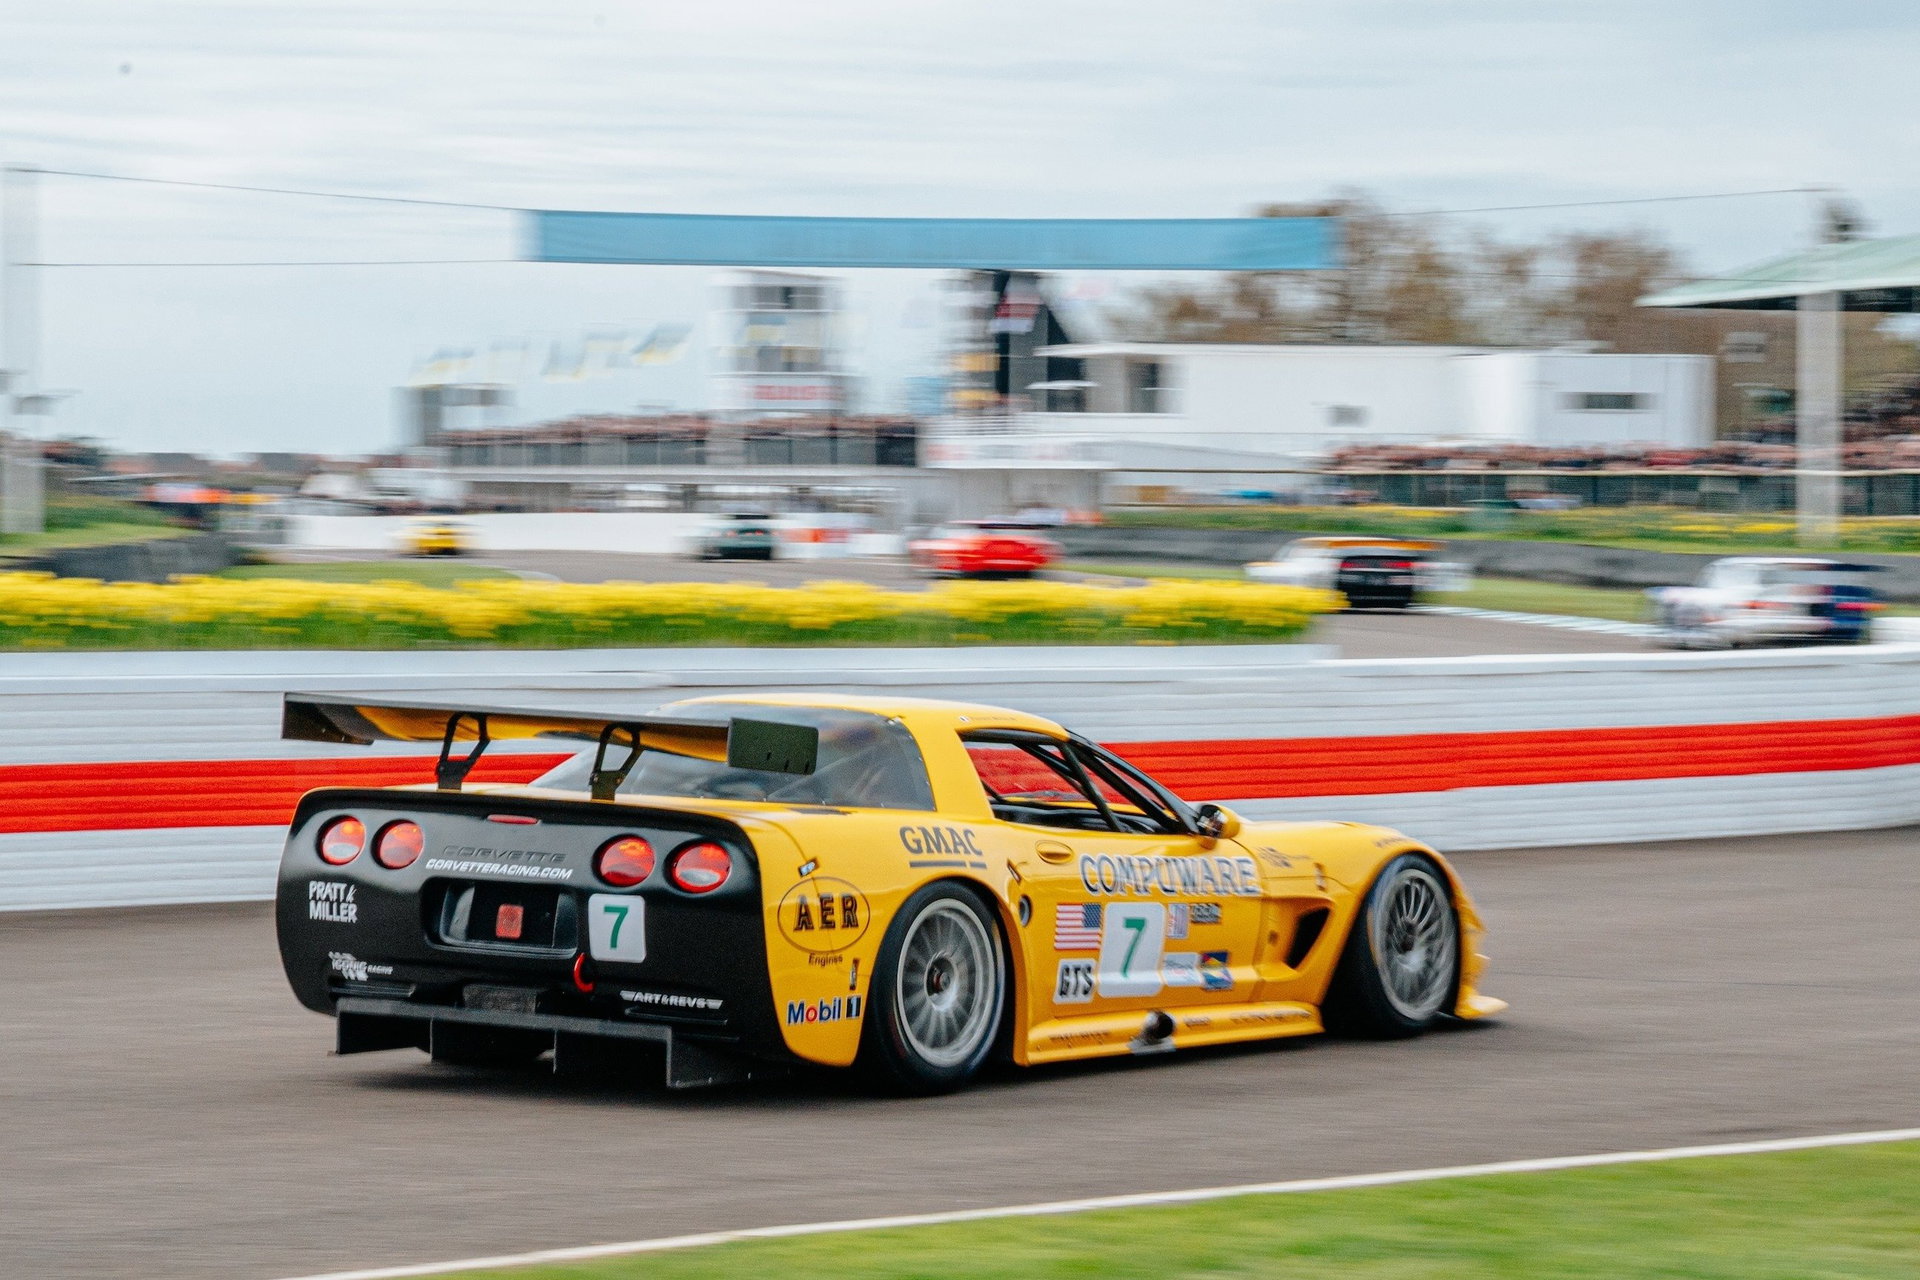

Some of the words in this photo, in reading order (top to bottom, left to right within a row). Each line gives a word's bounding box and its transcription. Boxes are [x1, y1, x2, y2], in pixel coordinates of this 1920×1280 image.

[443, 846, 567, 863] CORVETTE
[900, 826, 983, 856] GMAC
[425, 858, 574, 880] CORVETTERACING.COM
[1081, 855, 1261, 896] COMPUWARE
[309, 881, 347, 902] PRATT
[309, 900, 358, 923] MILLER
[793, 893, 859, 931] AER
[603, 904, 629, 950] 7
[808, 953, 843, 967] Engines
[1123, 917, 1147, 978] 7
[1058, 964, 1094, 997] GTS
[787, 997, 842, 1025] Mobil
[846, 996, 861, 1018] 1
